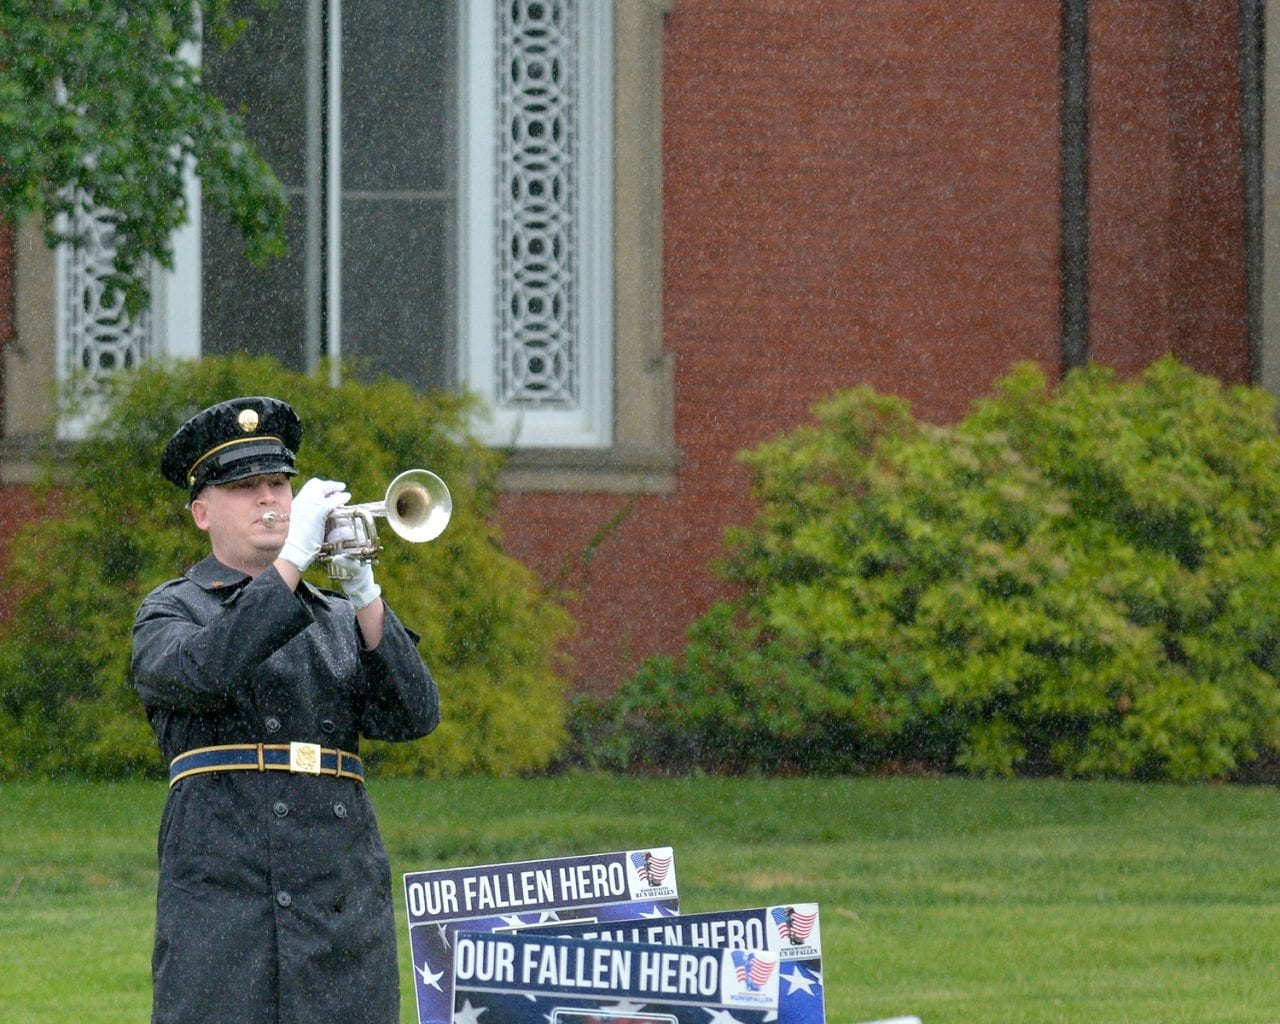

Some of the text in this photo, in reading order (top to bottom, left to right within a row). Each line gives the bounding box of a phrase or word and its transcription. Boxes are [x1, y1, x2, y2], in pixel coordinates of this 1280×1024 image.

[408, 862, 625, 916] OUR FALLEN HERO
[691, 917, 764, 951] HERO
[457, 938, 718, 996] OUR FALLEN HERO
